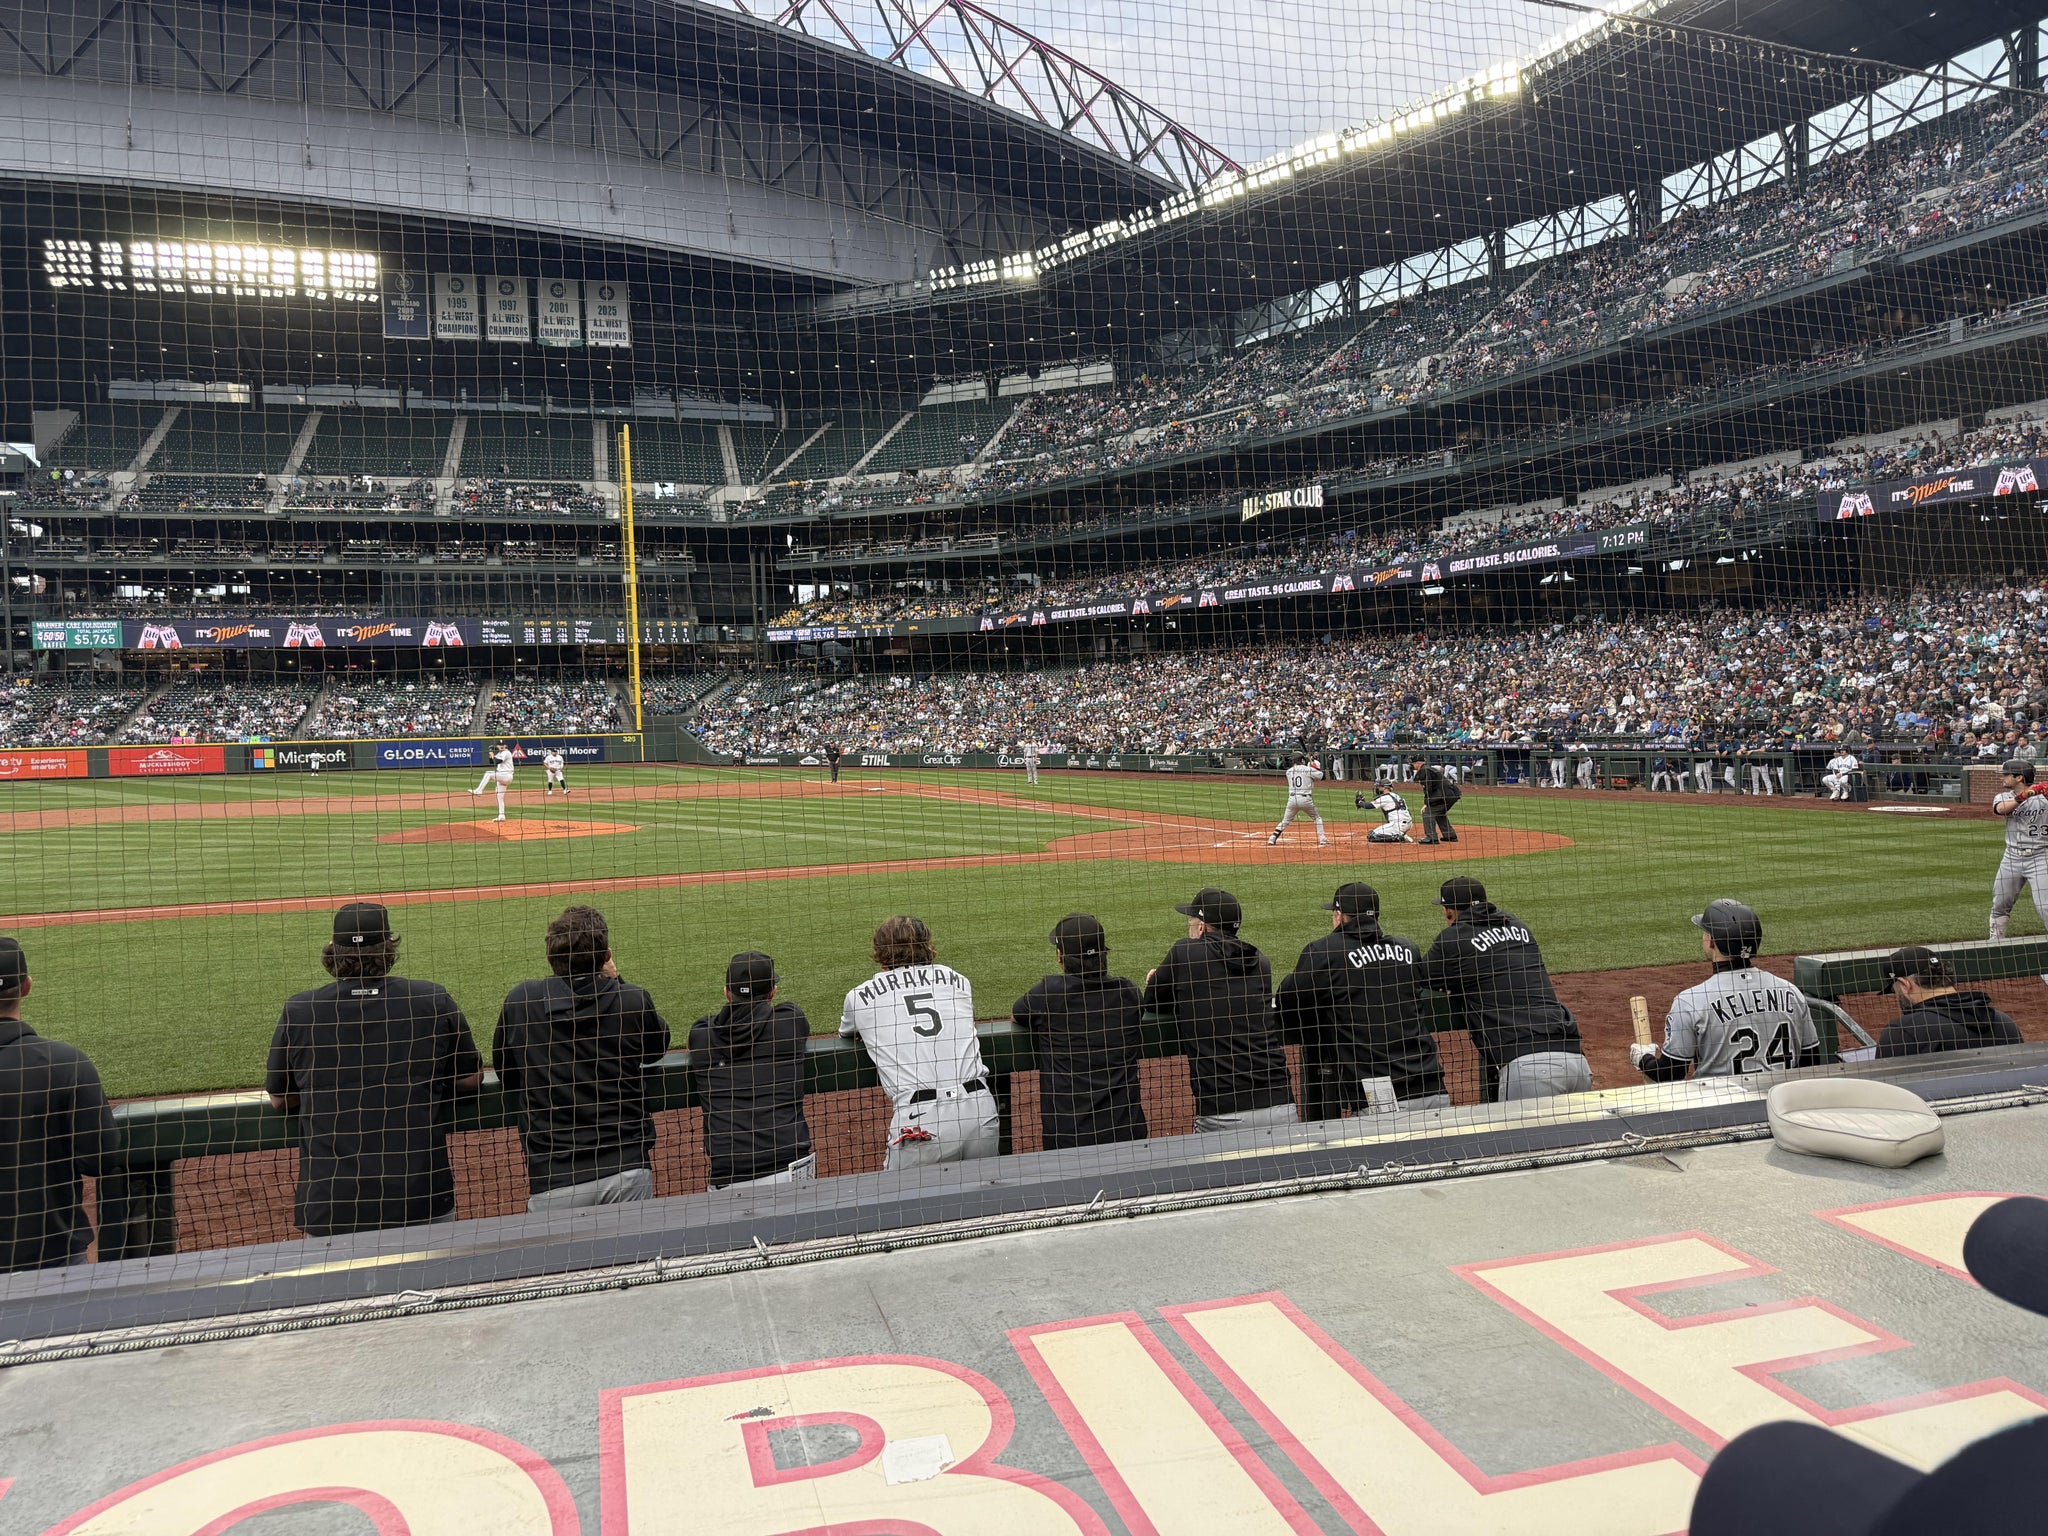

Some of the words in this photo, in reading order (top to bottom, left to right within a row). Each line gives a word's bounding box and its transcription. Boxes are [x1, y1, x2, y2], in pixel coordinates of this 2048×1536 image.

[447, 297, 467, 309] 1995
[498, 300, 517, 311] 1997
[549, 302, 569, 313] 2001
[441, 311, 453, 321] A.L.
[454, 311, 473, 321] WEST
[597, 305, 617, 316] 2025
[492, 313, 504, 323] A.L.
[505, 313, 524, 324] WEST
[543, 315, 556, 325] A.L.
[556, 316, 574, 326] WEST
[593, 319, 605, 328] A.L.
[605, 319, 622, 329] WEST
[438, 323, 478, 335] CHAMPIONS
[488, 325, 529, 336] CHAMPIONS
[540, 327, 579, 339] CHAMPIONS
[589, 330, 627, 341] CHAMPIONS
[1294, 484, 1324, 508] CLUB
[1892, 490, 1909, 502] IT'S
[1907, 475, 1957, 506] Miller
[1602, 534, 1625, 548] 7:12
[1627, 531, 1644, 545] PM
[1450, 558, 1475, 572] GREAT
[1475, 554, 1503, 569] TASTE.
[1503, 551, 1516, 564] 96
[1516, 544, 1561, 562] CALORIES.
[1372, 566, 1402, 585] Miller
[1225, 589, 1247, 600] GREAT
[1248, 586, 1272, 597] TASTE.
[1273, 584, 1284, 594] 96
[1284, 579, 1323, 593] CALORIES.
[1051, 610, 1068, 619] GREAT
[1068, 608, 1087, 618] TASTE.
[1087, 606, 1096, 615] 96
[1097, 603, 1126, 615] CALORIES.
[82, 621, 118, 629] FOUNDATION
[195, 629, 212, 638] IT'S
[210, 623, 255, 642] Miller
[337, 628, 353, 637] IT'S
[351, 623, 397, 642] Miller
[813, 631, 835, 640] $5,765
[74, 634, 116, 646] $5,765
[278, 750, 347, 764] Micrsoft
[383, 748, 446, 760] GLOBAL
[527, 747, 567, 758] Benjain
[10, 757, 23, 766] tv
[30, 757, 67, 765] Experience
[139, 761, 190, 769] MUCKLESHOOT
[861, 754, 890, 766] STIHL
[923, 754, 943, 764] Great
[944, 754, 961, 766] Clips
[1009, 757, 1041, 765] LES
[2028, 824, 2048, 837] 23
[1471, 925, 1530, 952] CHICAGO
[1348, 943, 1413, 969] CHICAGO
[858, 968, 965, 1006] MURAKAMI
[1710, 988, 1796, 1024] KELENIC
[903, 992, 944, 1038] 5
[1729, 1021, 1795, 1076] 24
[0, 1230, 2048, 1536] OBILE
